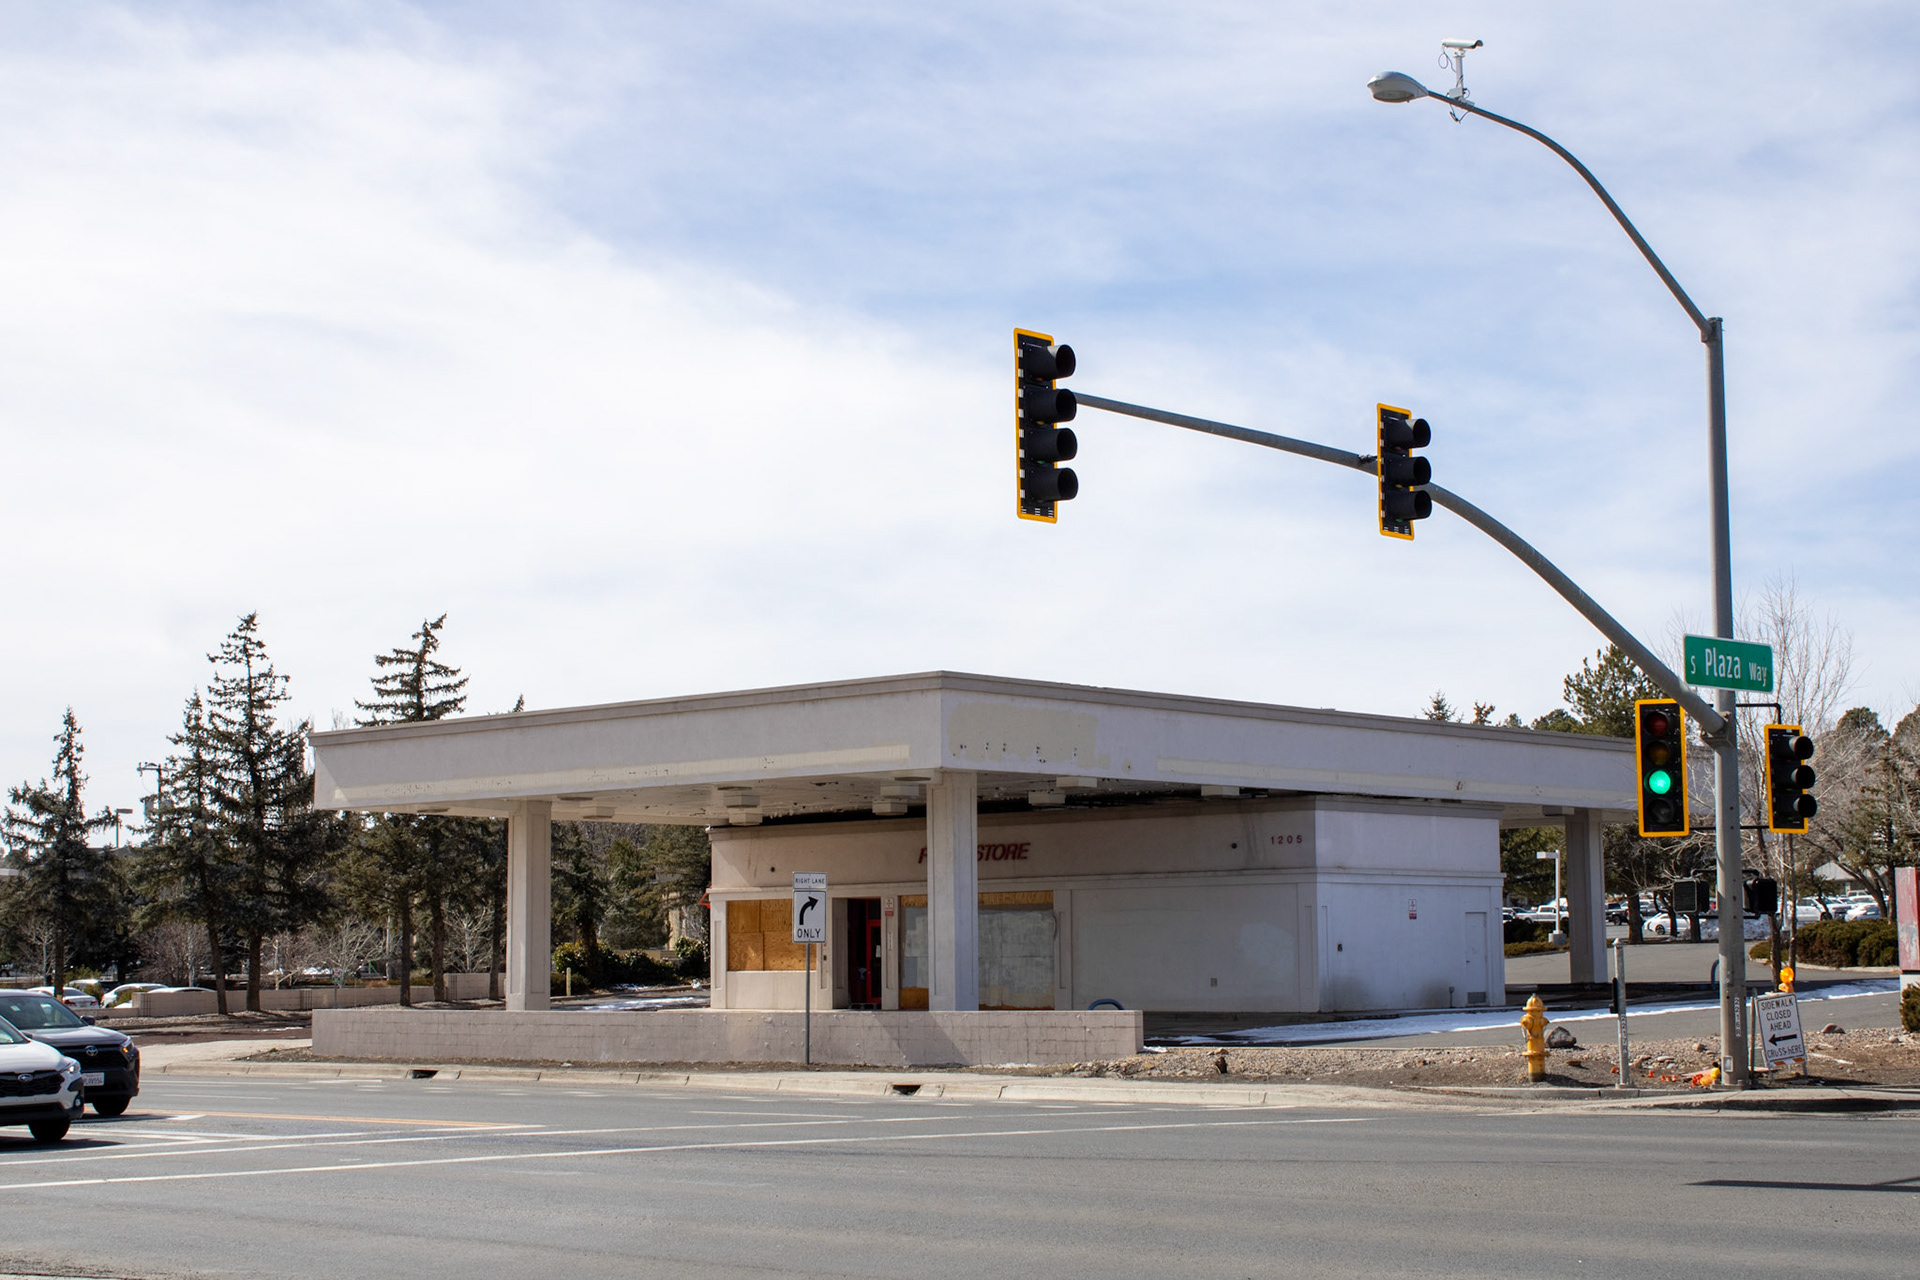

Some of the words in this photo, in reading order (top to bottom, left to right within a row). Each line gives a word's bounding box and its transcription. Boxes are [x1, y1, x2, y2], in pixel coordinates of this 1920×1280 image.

[1690, 655, 1696, 675] S
[1705, 646, 1741, 679] Plaza
[1748, 662, 1768, 687] Way
[1271, 834, 1303, 845] 1205
[977, 842, 1031, 862] STORE
[796, 928, 821, 939] ONLY
[1761, 997, 1794, 1011] SIDEWALK
[1766, 1009, 1792, 1021] CLOSED
[1769, 1020, 1792, 1031] AHEAD
[1767, 1047, 1787, 1058] CROSS
[1787, 1044, 1803, 1055] HERE
